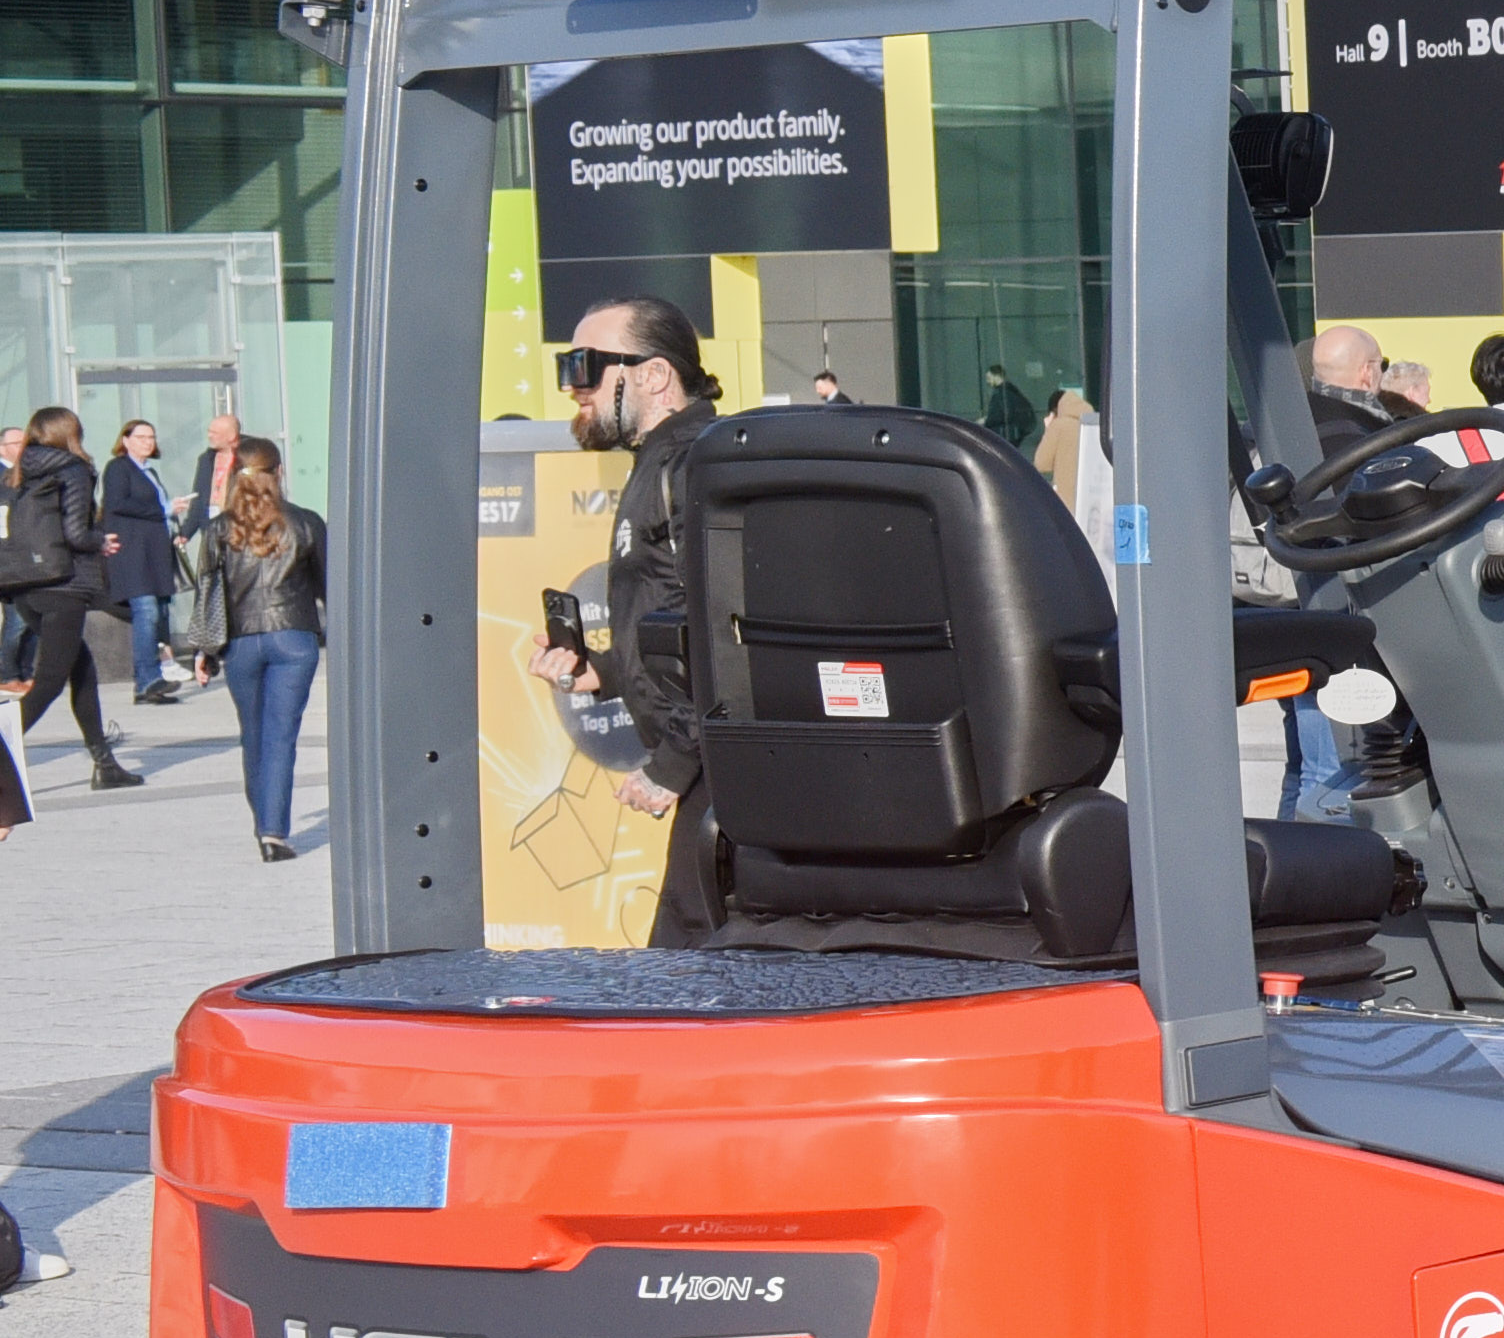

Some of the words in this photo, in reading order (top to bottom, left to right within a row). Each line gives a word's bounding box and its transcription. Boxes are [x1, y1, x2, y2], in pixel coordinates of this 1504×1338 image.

[1335, 41, 1366, 64] Hall
[1367, 24, 1389, 62] 9
[1416, 36, 1463, 59] Booth
[569, 117, 653, 151] Growing
[655, 122, 691, 144] our
[695, 114, 773, 145] product
[777, 108, 846, 144] family.
[571, 154, 672, 190] Expanding
[675, 157, 721, 187] your
[726, 148, 848, 187] possibilities.
[580, 714, 608, 734] Tag
